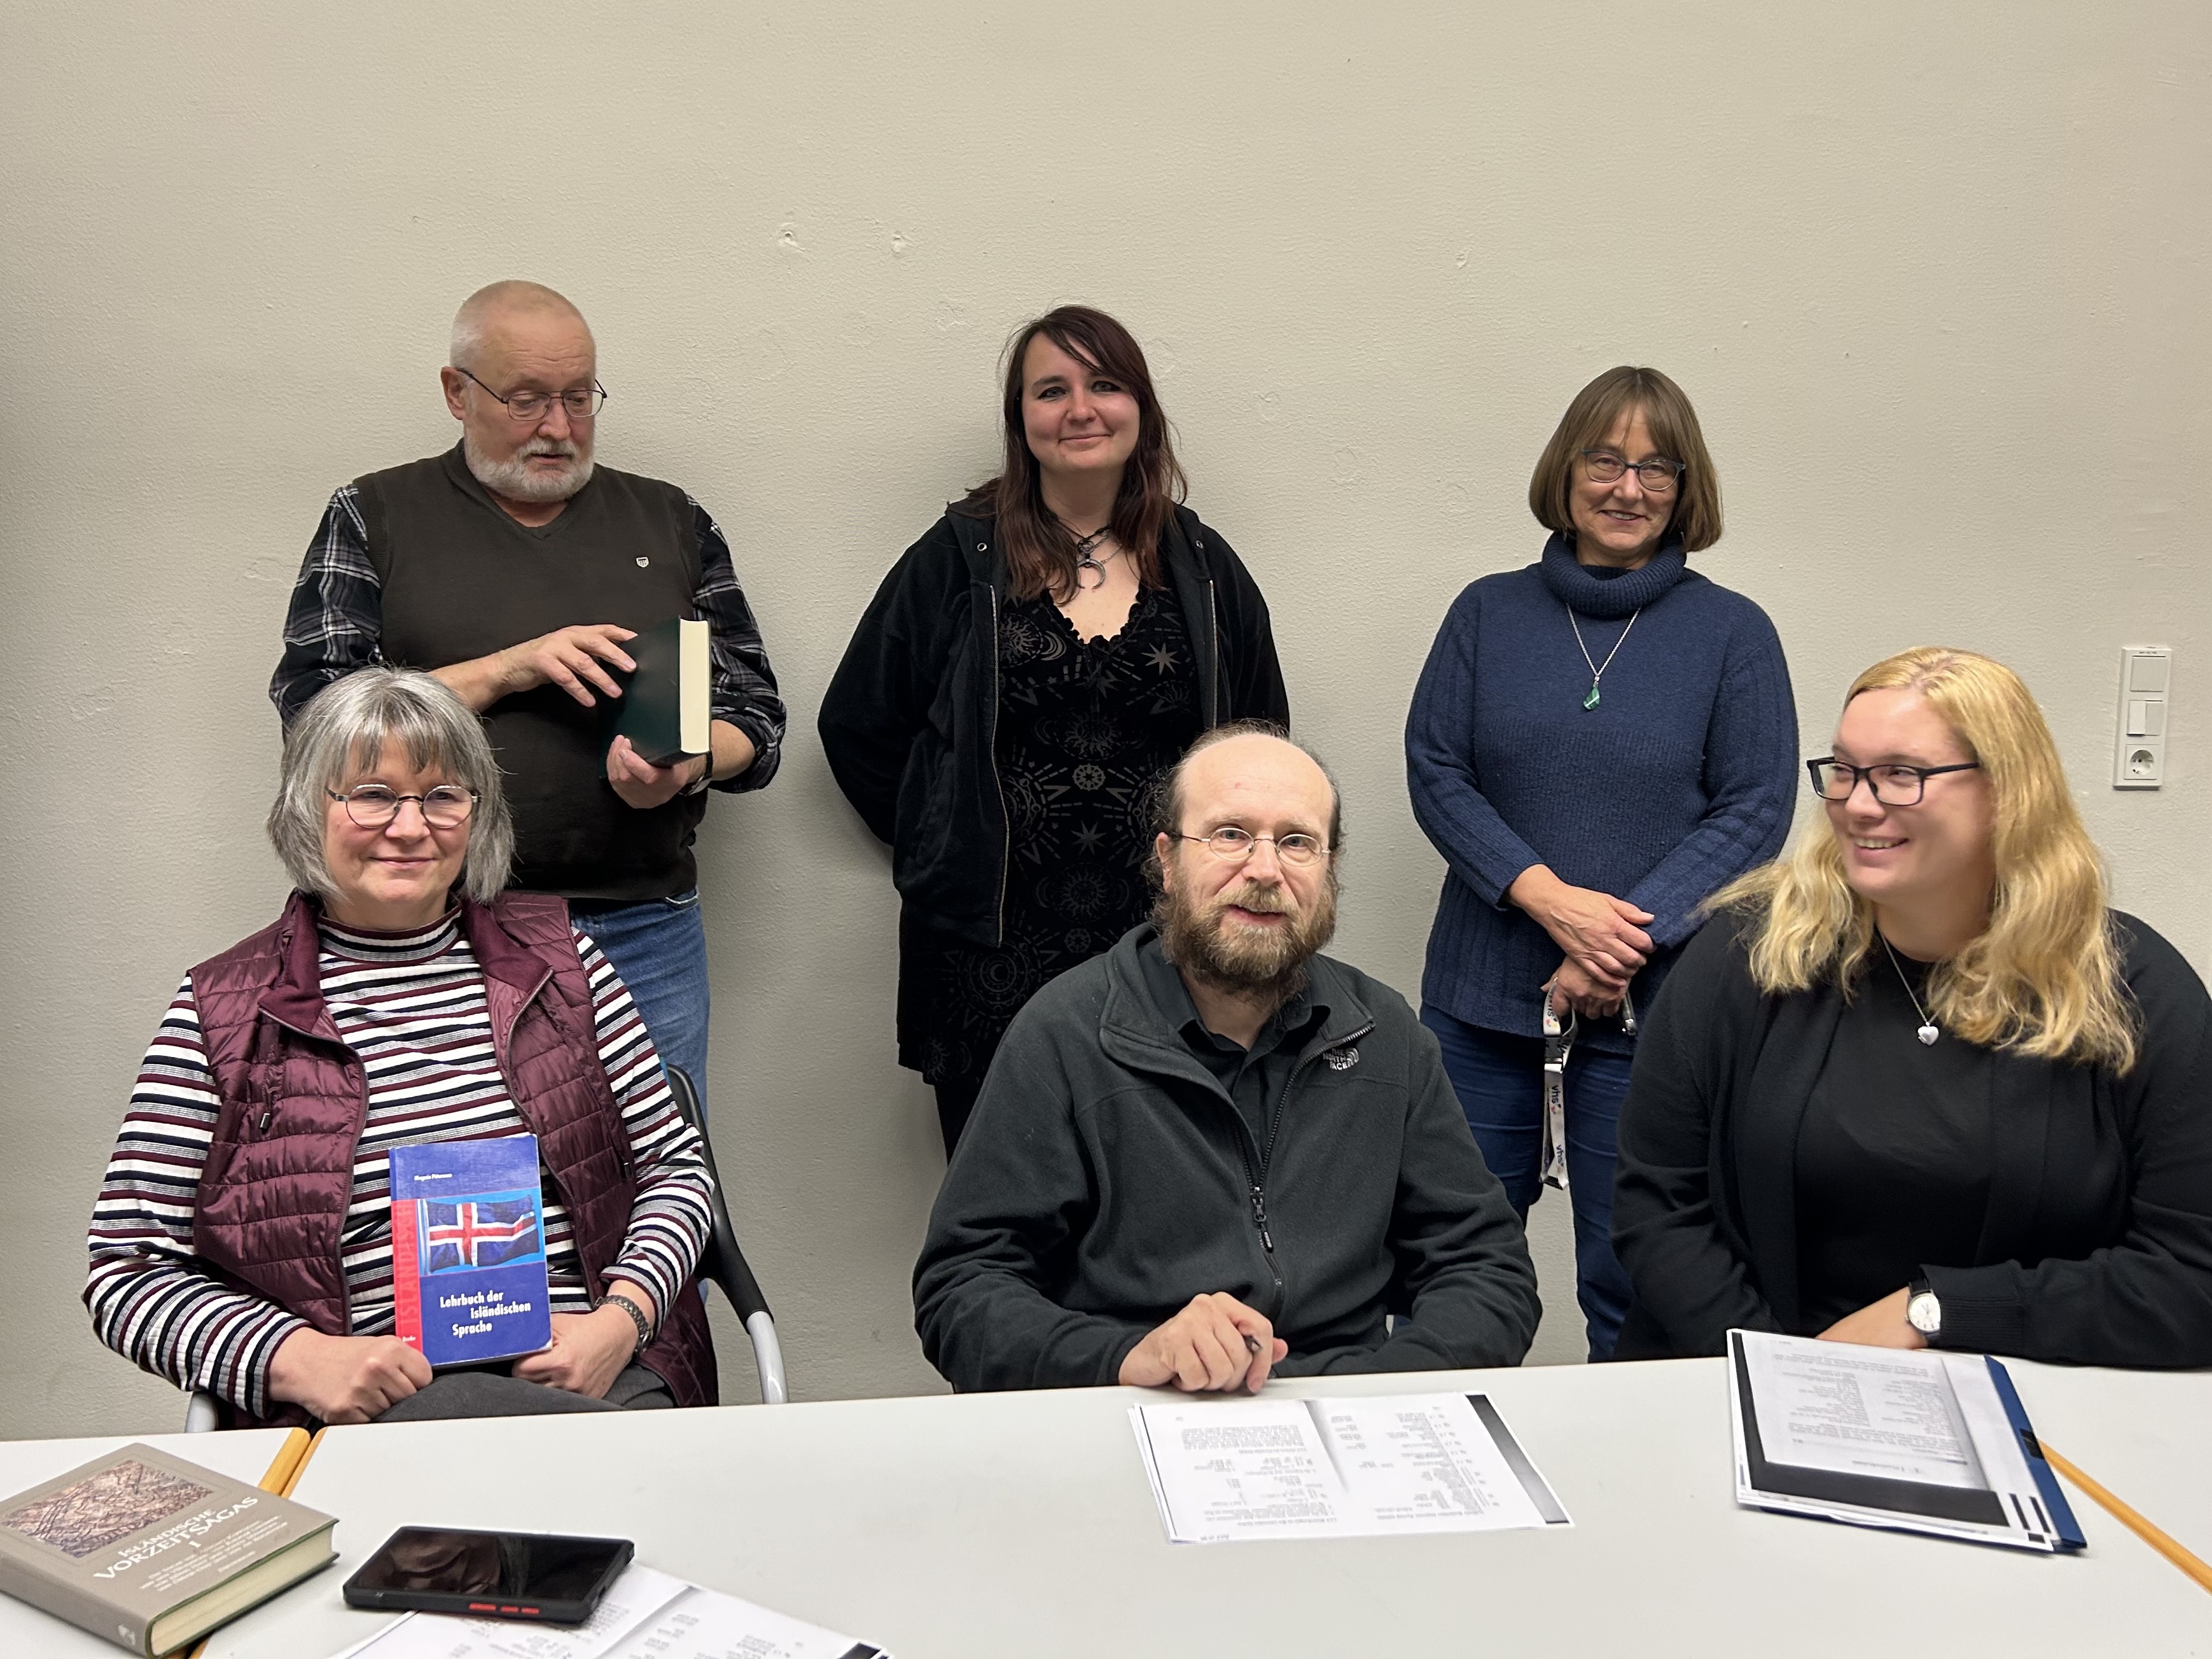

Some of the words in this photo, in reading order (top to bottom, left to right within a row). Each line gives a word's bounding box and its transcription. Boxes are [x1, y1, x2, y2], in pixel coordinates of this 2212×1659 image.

[1551, 1084, 1561, 1103] vhs
[440, 1291, 485, 1308] Lehrbuch
[487, 1290, 504, 1303] der
[470, 1301, 531, 1319] isländischen
[452, 1320, 492, 1338] Sprache
[93, 1496, 258, 1578] VORZEITSAGAS
